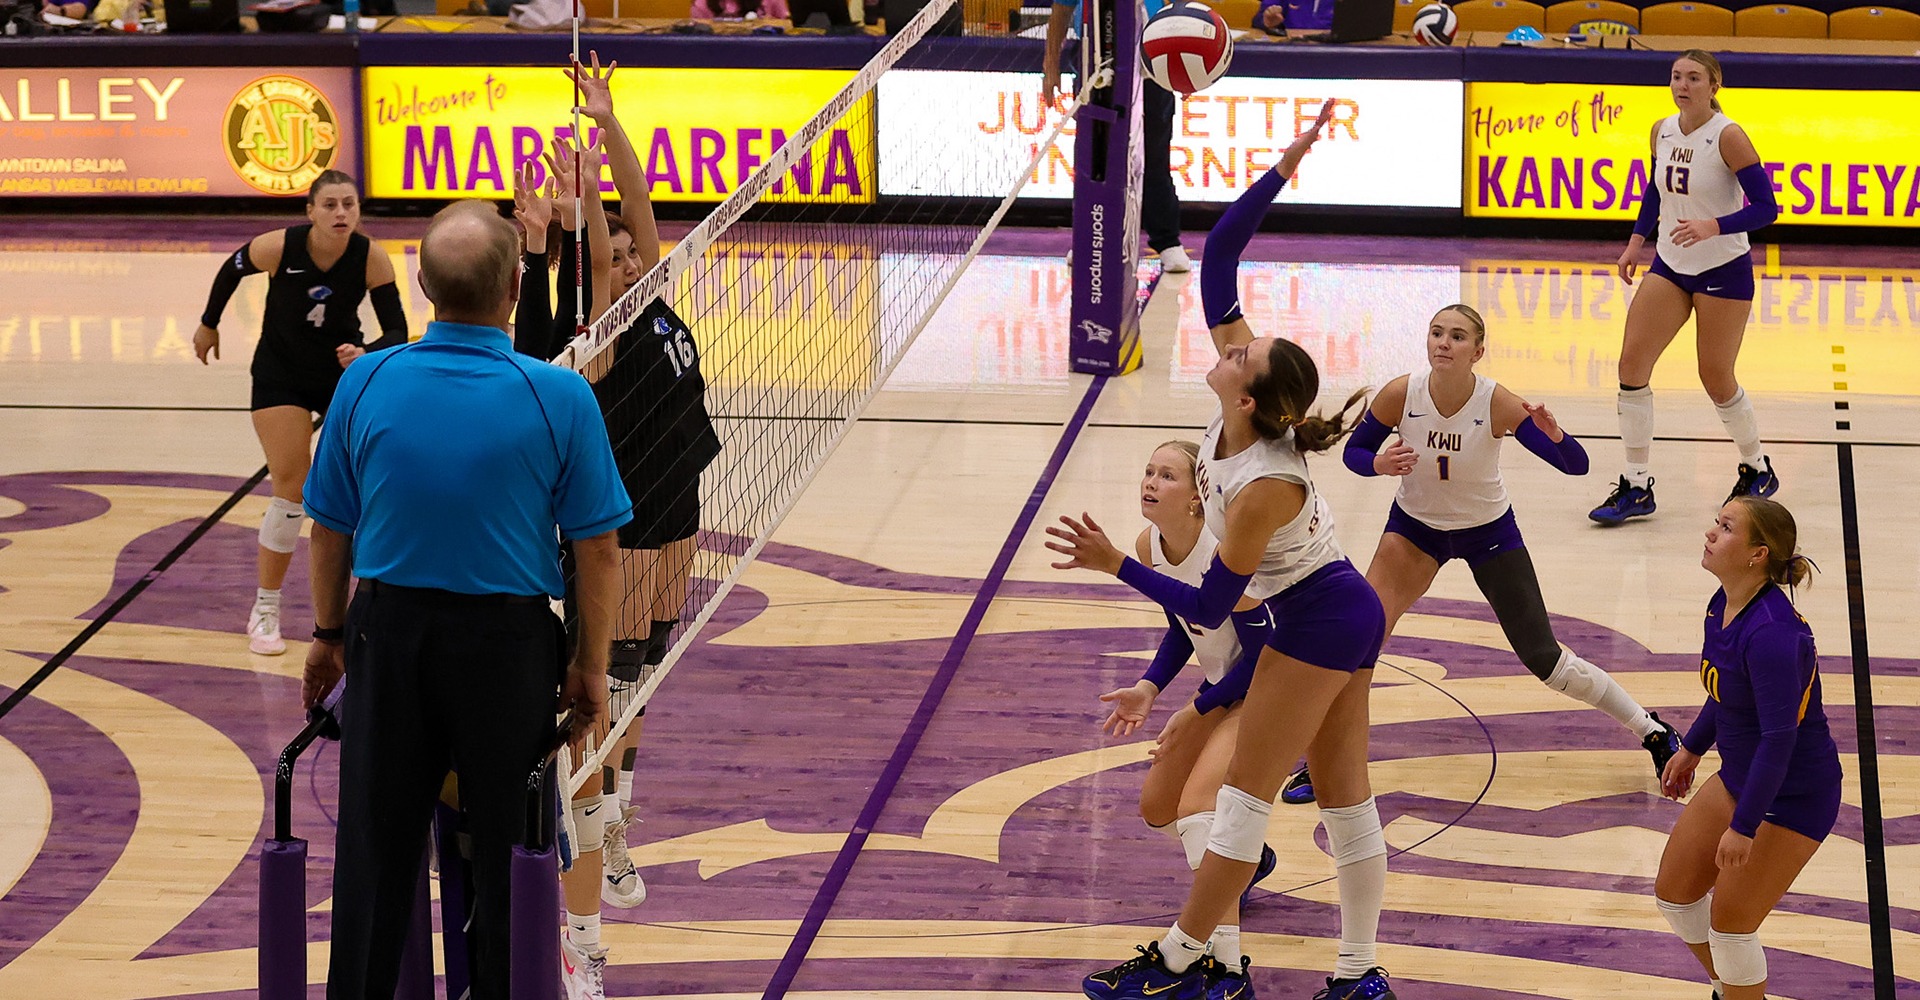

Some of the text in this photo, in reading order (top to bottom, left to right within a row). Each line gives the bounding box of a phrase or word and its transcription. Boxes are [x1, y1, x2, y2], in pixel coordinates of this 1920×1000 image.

[375, 74, 506, 125] Welcome to
[978, 91, 1077, 135] JUS
[1181, 94, 1360, 141] ETTER
[1472, 91, 1623, 149] Home of the
[403, 126, 614, 192] MAB
[1670, 147, 1694, 163] KWU
[0, 178, 52, 192] ANSAS
[1478, 156, 1920, 217] KANSA ESLEY
[1666, 165, 1690, 195] 13
[1089, 204, 1104, 304] sports imports
[306, 303, 326, 327] 4
[664, 329, 695, 377] 16
[1427, 430, 1462, 452] KWU
[1436, 455, 1451, 480] 1
[1700, 659, 1721, 703] 10
